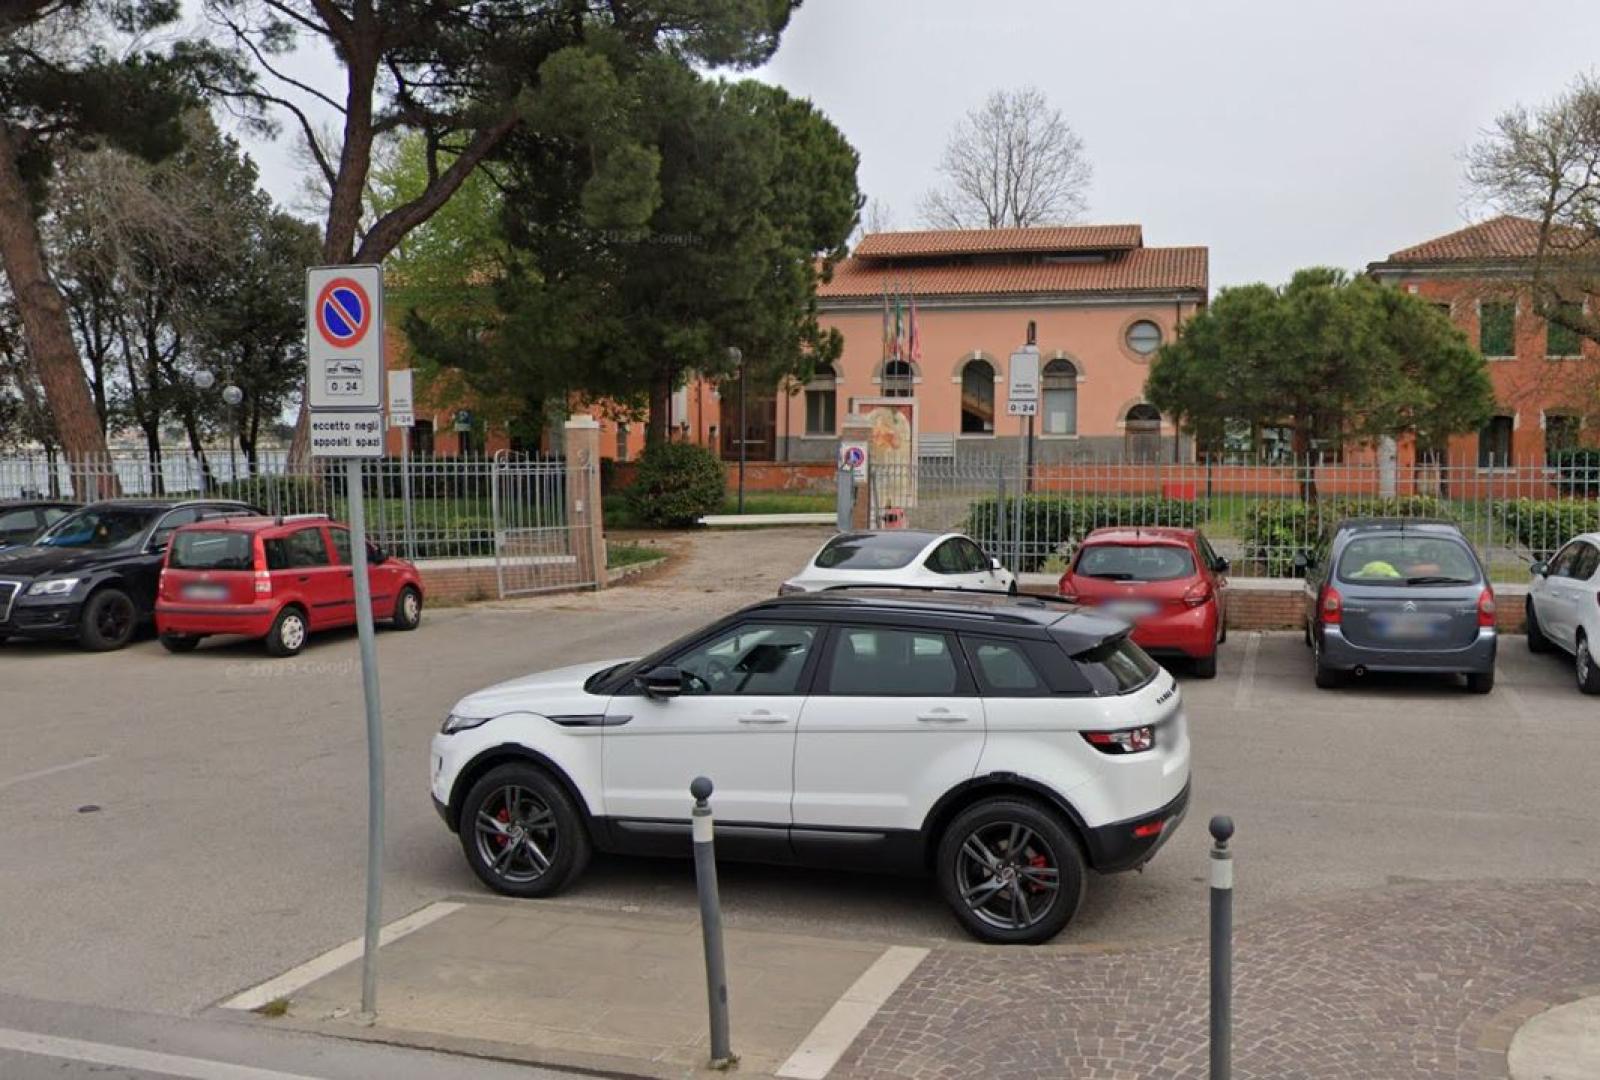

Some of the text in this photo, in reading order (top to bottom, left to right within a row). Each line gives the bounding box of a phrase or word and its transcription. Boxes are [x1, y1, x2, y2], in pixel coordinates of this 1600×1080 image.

[331, 382, 338, 391] 0
[346, 381, 357, 391] 24
[1022, 403, 1035, 412] 24
[313, 421, 379, 433] eccetto negli
[313, 436, 380, 448] appositi spazi
